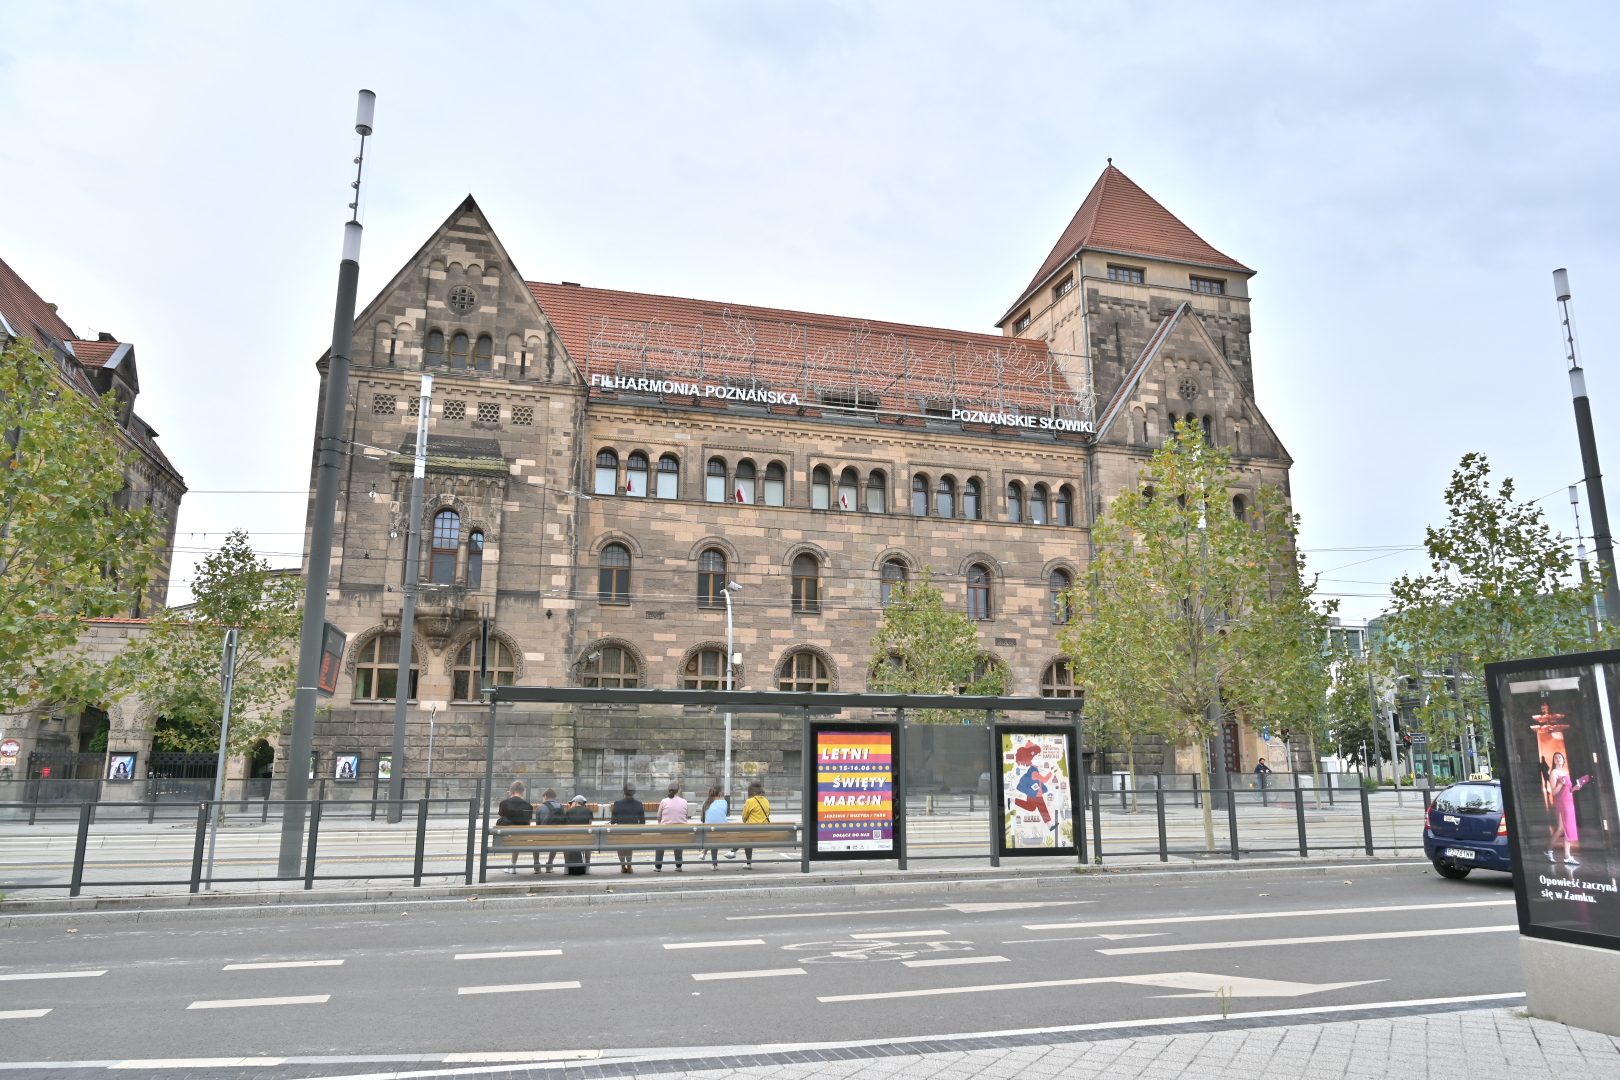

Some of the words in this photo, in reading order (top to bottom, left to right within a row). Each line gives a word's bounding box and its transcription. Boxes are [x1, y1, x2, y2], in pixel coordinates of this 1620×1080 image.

[591, 374, 700, 396] FILHARMONIA
[705, 386, 800, 405] POZNAŃSKA
[952, 409, 1037, 428] POZNAŃSKIE
[1040, 417, 1093, 433] SŁOWIKI
[822, 748, 869, 760] LETNI
[832, 775, 887, 790] ŚWIĘTY
[823, 795, 882, 807] MARCIN
[1539, 875, 1580, 888] Opowieść
[1582, 882, 1617, 892] zaczyna
[1541, 889, 1554, 900] się
[1564, 890, 1597, 903] Zamku.
